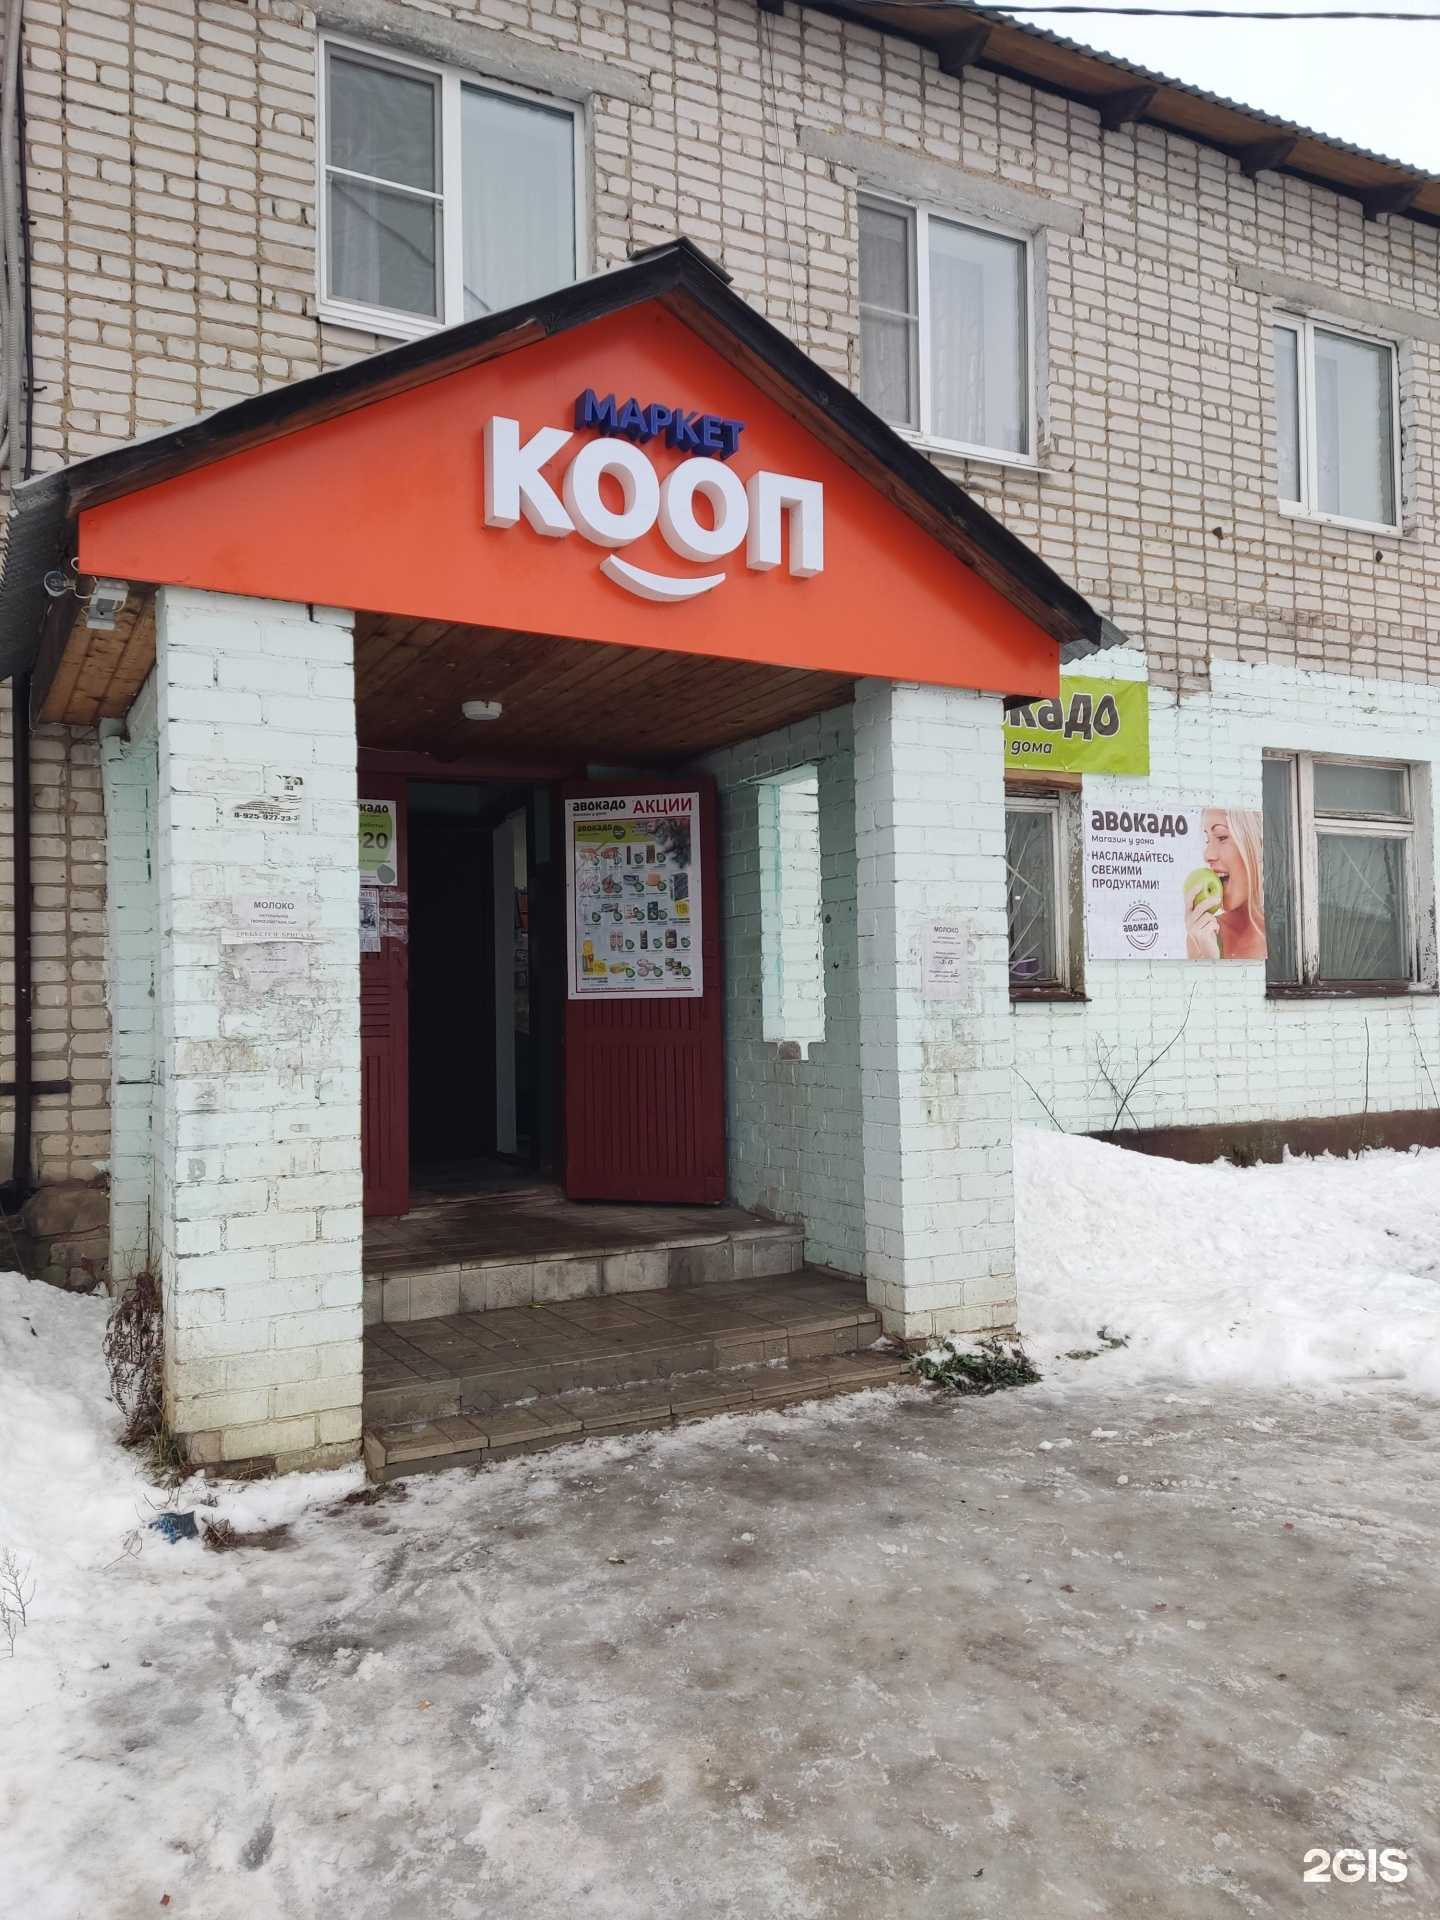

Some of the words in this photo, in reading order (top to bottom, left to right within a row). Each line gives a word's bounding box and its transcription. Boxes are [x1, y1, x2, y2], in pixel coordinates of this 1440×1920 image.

[575, 388, 746, 460] МАРКЕТ
[1001, 692, 1120, 741] кадо
[1011, 740, 1053, 755] дома
[573, 800, 626, 812] авокадо
[633, 798, 692, 814] АКЦИИ
[1091, 810, 1188, 837] авокадо
[1091, 835, 1126, 843] Магазин
[1129, 837, 1134, 845] у
[1091, 851, 1174, 863] НАСЛАЖДАЙТЕСЬ
[1091, 865, 1142, 875] СВЕЖИМИ
[1092, 879, 1160, 890] ПРОДУКТАМИ!
[253, 901, 295, 910] МОЛОКО
